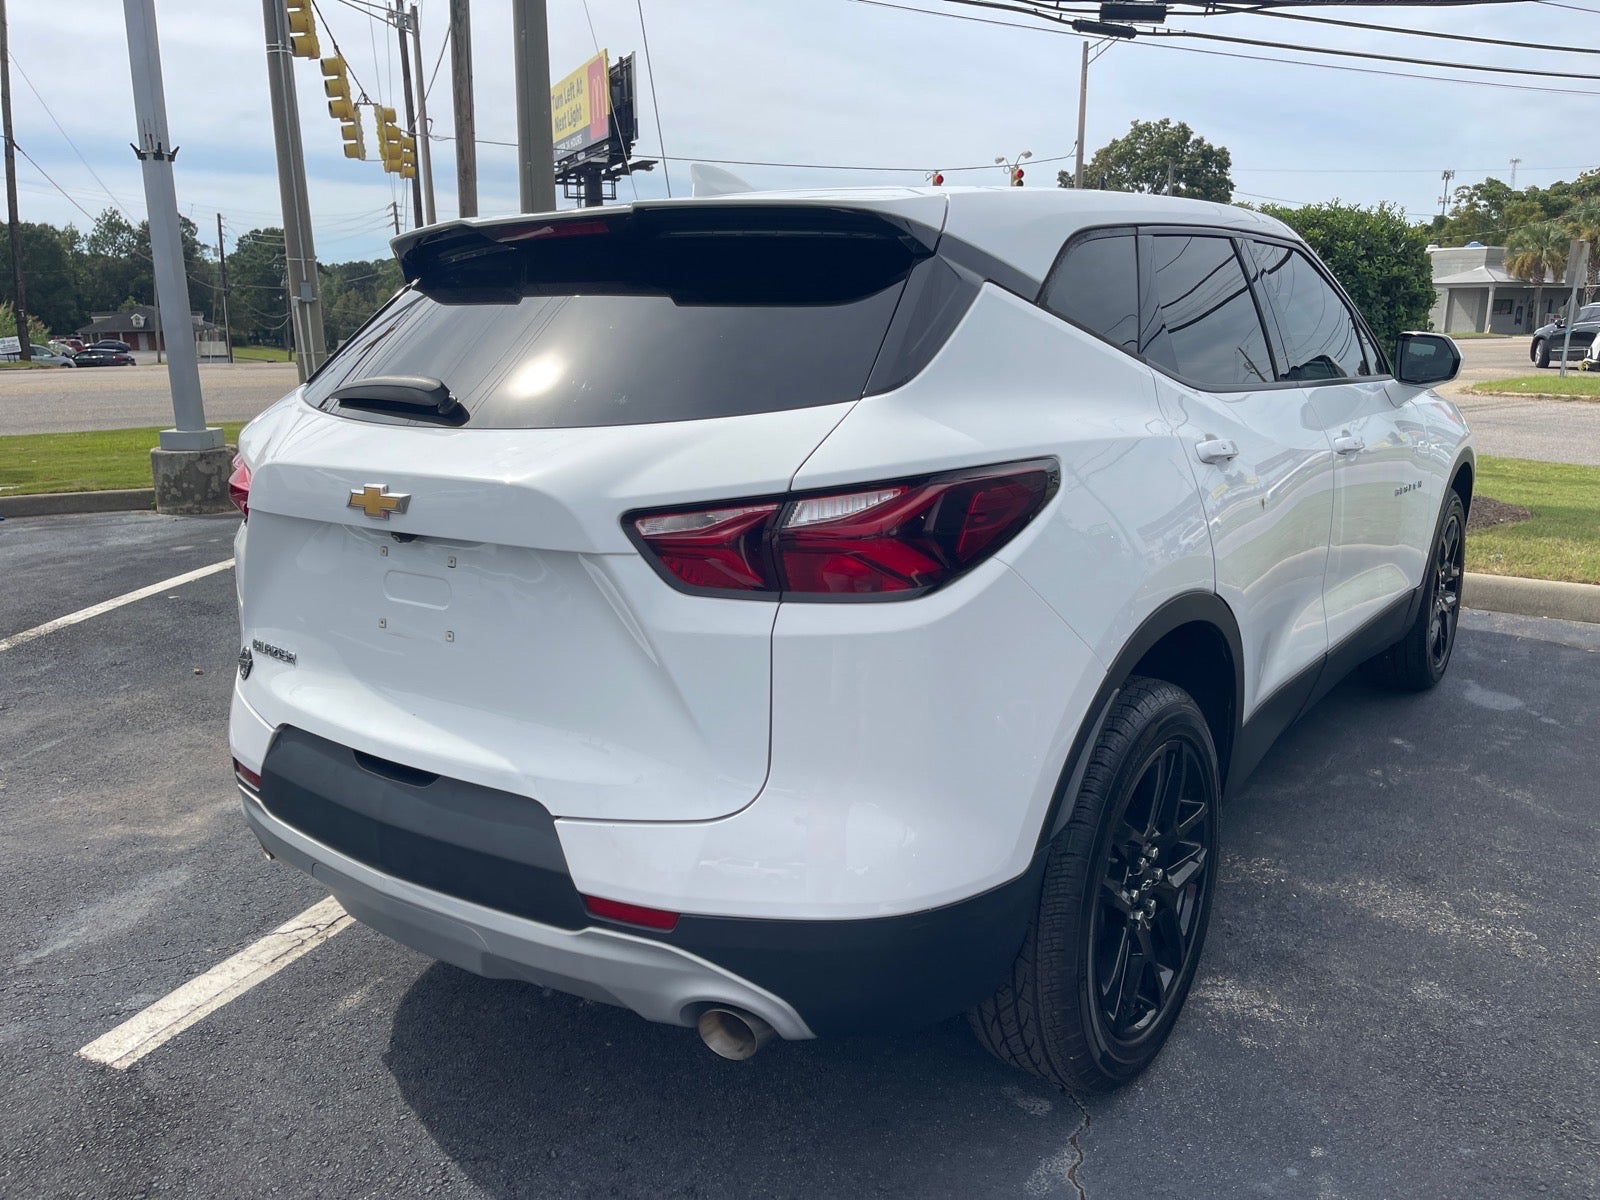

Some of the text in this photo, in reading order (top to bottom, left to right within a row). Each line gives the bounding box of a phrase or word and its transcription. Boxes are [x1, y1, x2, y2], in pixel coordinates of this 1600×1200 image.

[563, 82, 576, 104] Left
[576, 77, 583, 96] At
[554, 102, 582, 132] Next Light
[252, 639, 297, 666] BLAZER
